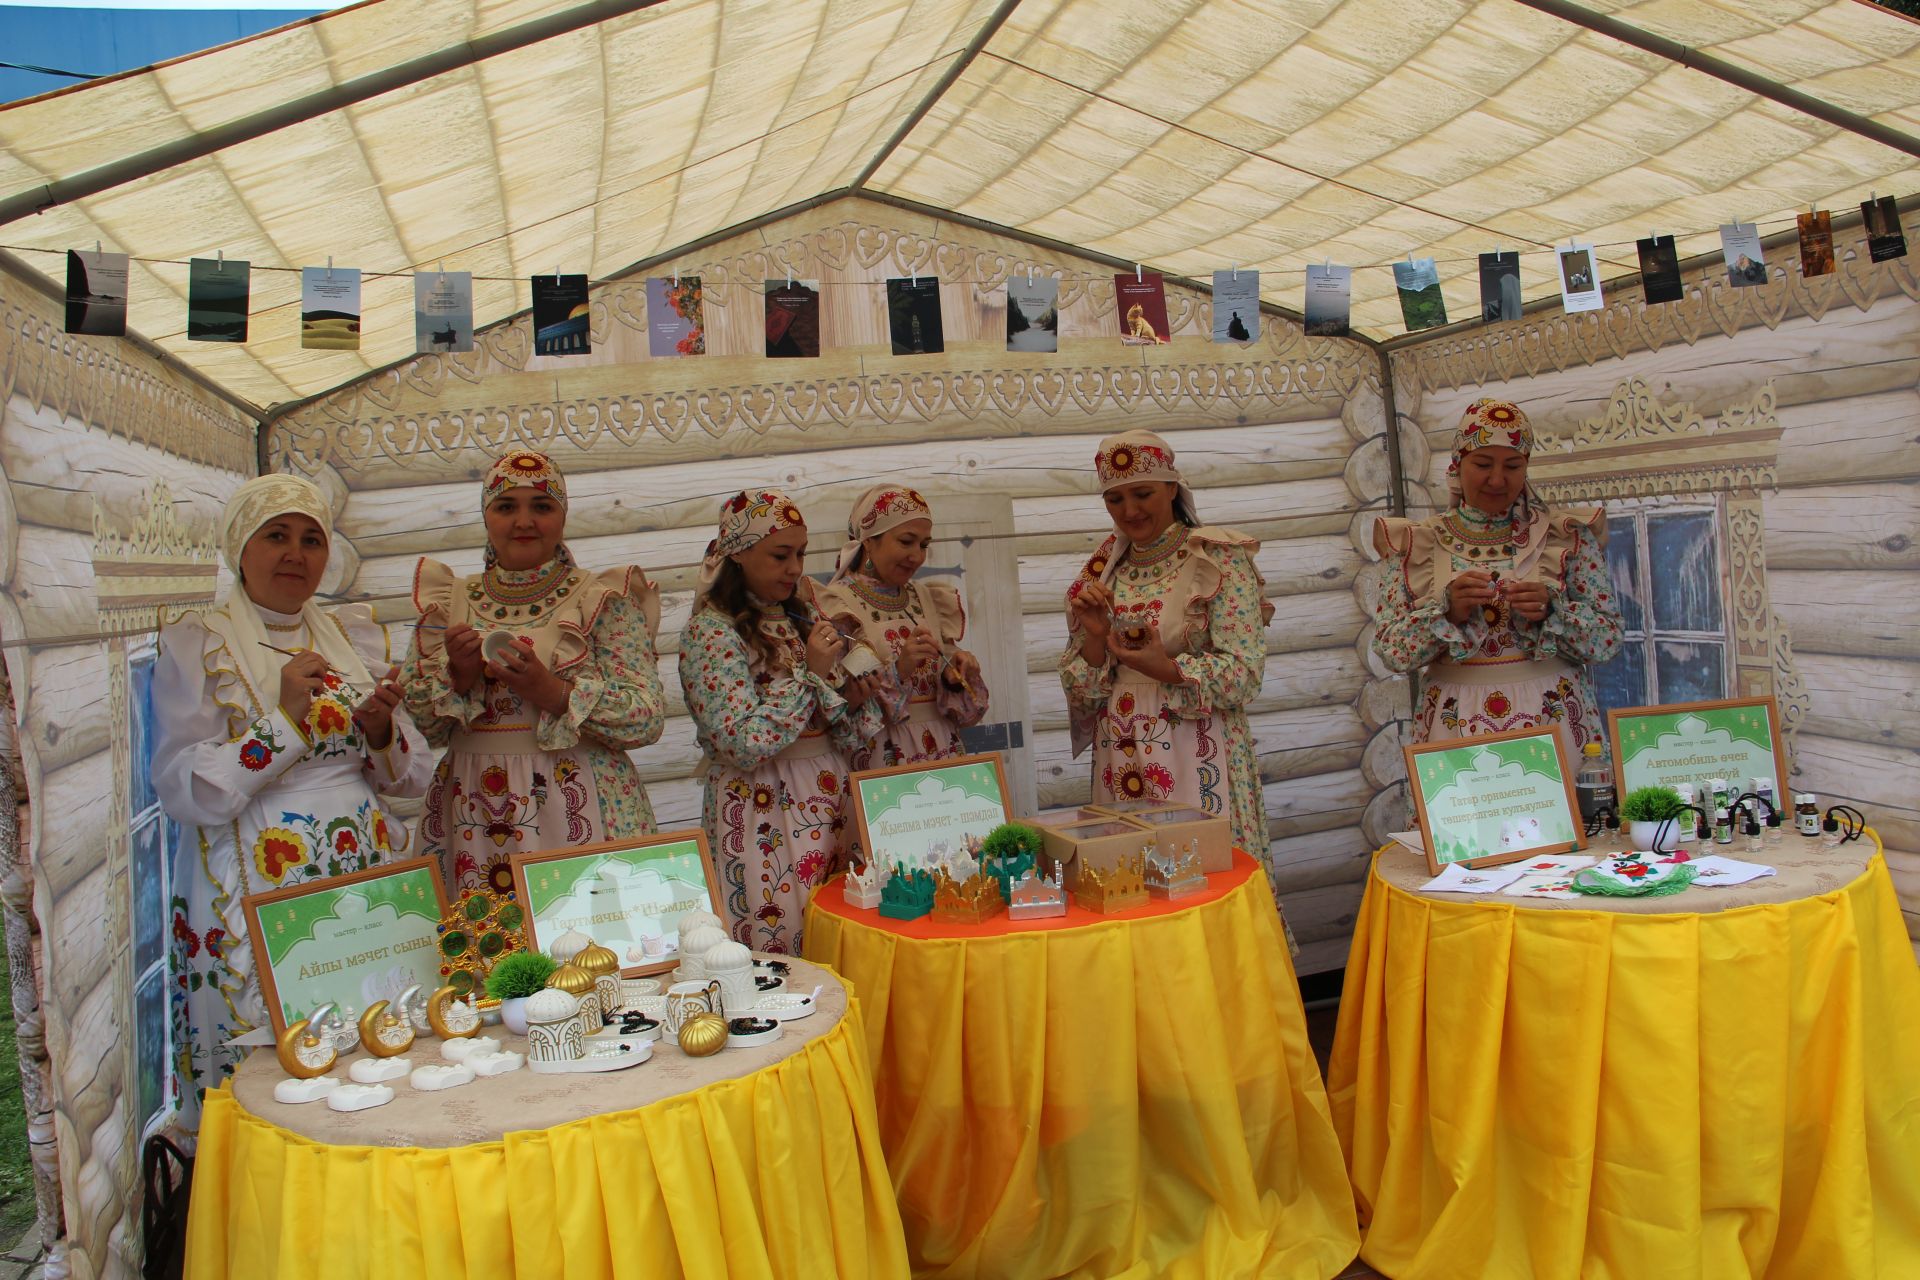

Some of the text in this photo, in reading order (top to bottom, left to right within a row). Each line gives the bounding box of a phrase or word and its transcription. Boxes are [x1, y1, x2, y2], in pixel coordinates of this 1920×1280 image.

[1646, 752, 1749, 769] Автомобиль өчен
[1658, 774, 1691, 785] хәләл
[1450, 786, 1536, 807] Татар орнаменты
[923, 815, 952, 830] мәчет
[960, 808, 999, 823] шәмдәл
[299, 935, 433, 980] Айлы мәчет сыны
